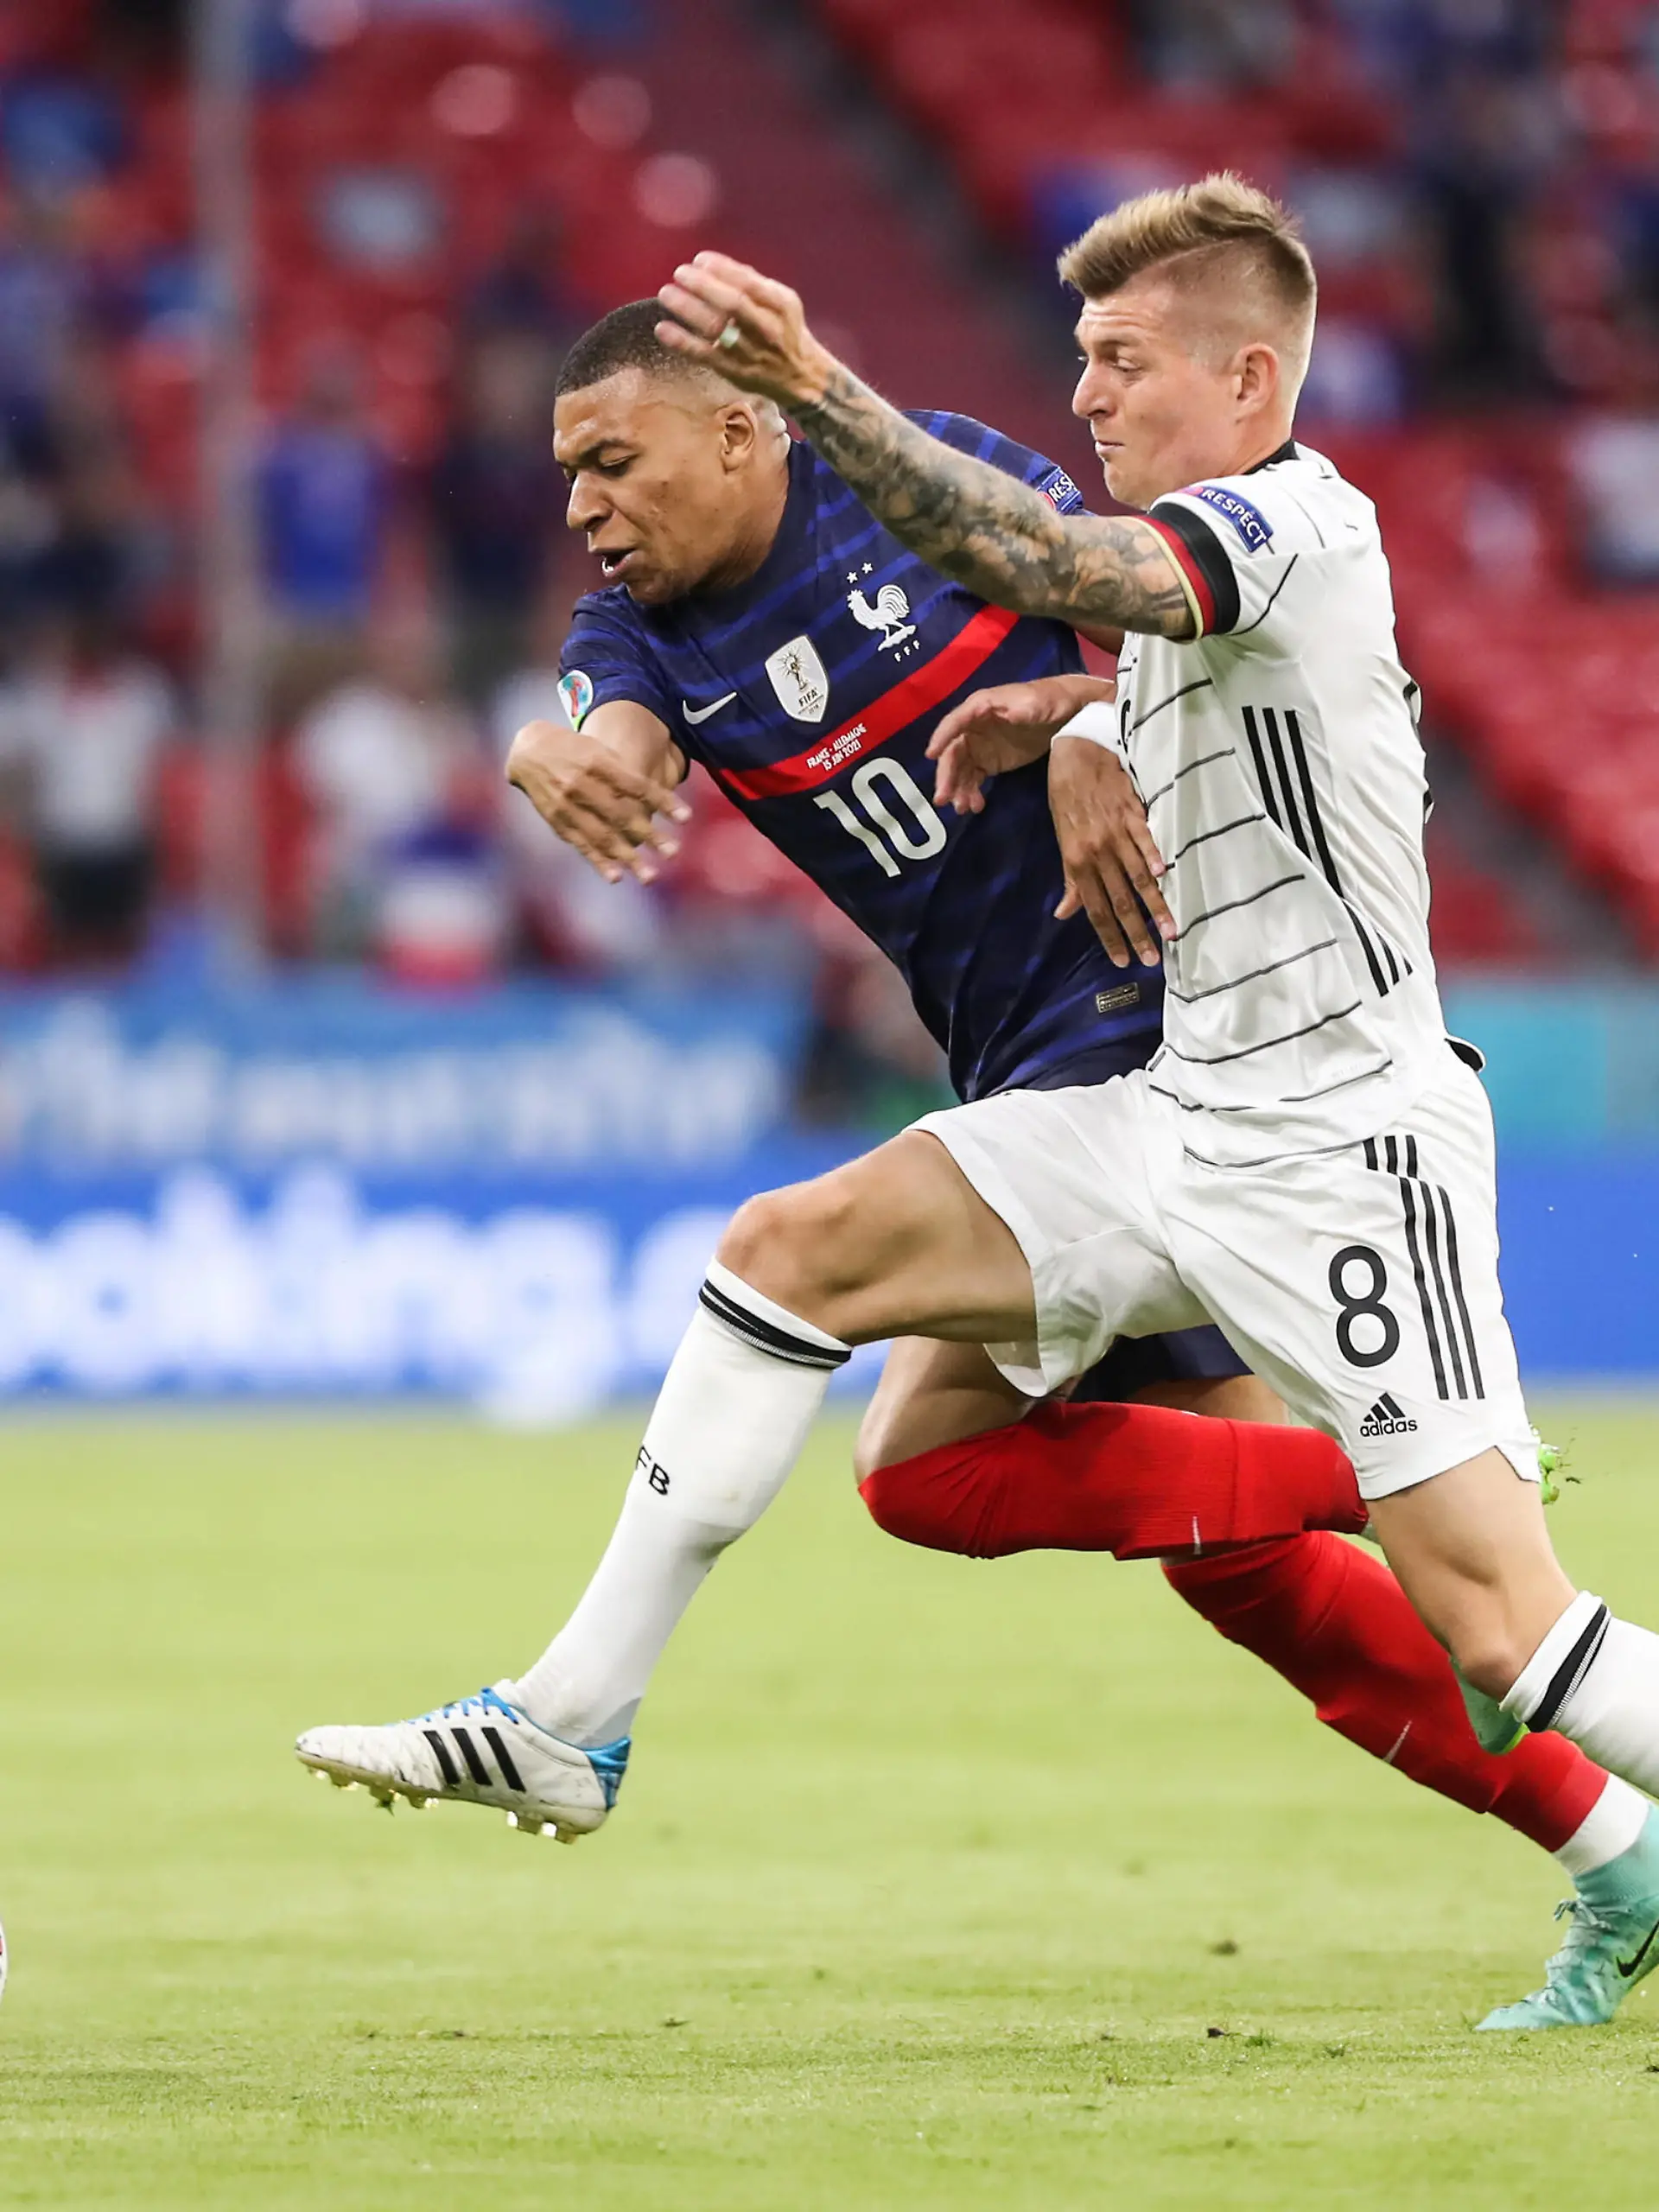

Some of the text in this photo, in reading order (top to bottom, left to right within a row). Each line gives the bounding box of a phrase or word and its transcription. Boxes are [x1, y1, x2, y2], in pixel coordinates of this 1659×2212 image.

[1048, 473, 1074, 502] RES
[1202, 489, 1267, 544] RESPECT
[798, 689, 818, 707] FIFA
[806, 747, 830, 769] FRANCE
[832, 722, 867, 752] ALLEMAGNE
[823, 760, 832, 771] 15
[842, 739, 862, 757] 2021
[812, 757, 947, 878] 10
[1328, 1245, 1400, 1367] 8
[1360, 1419, 1418, 1437] adidas
